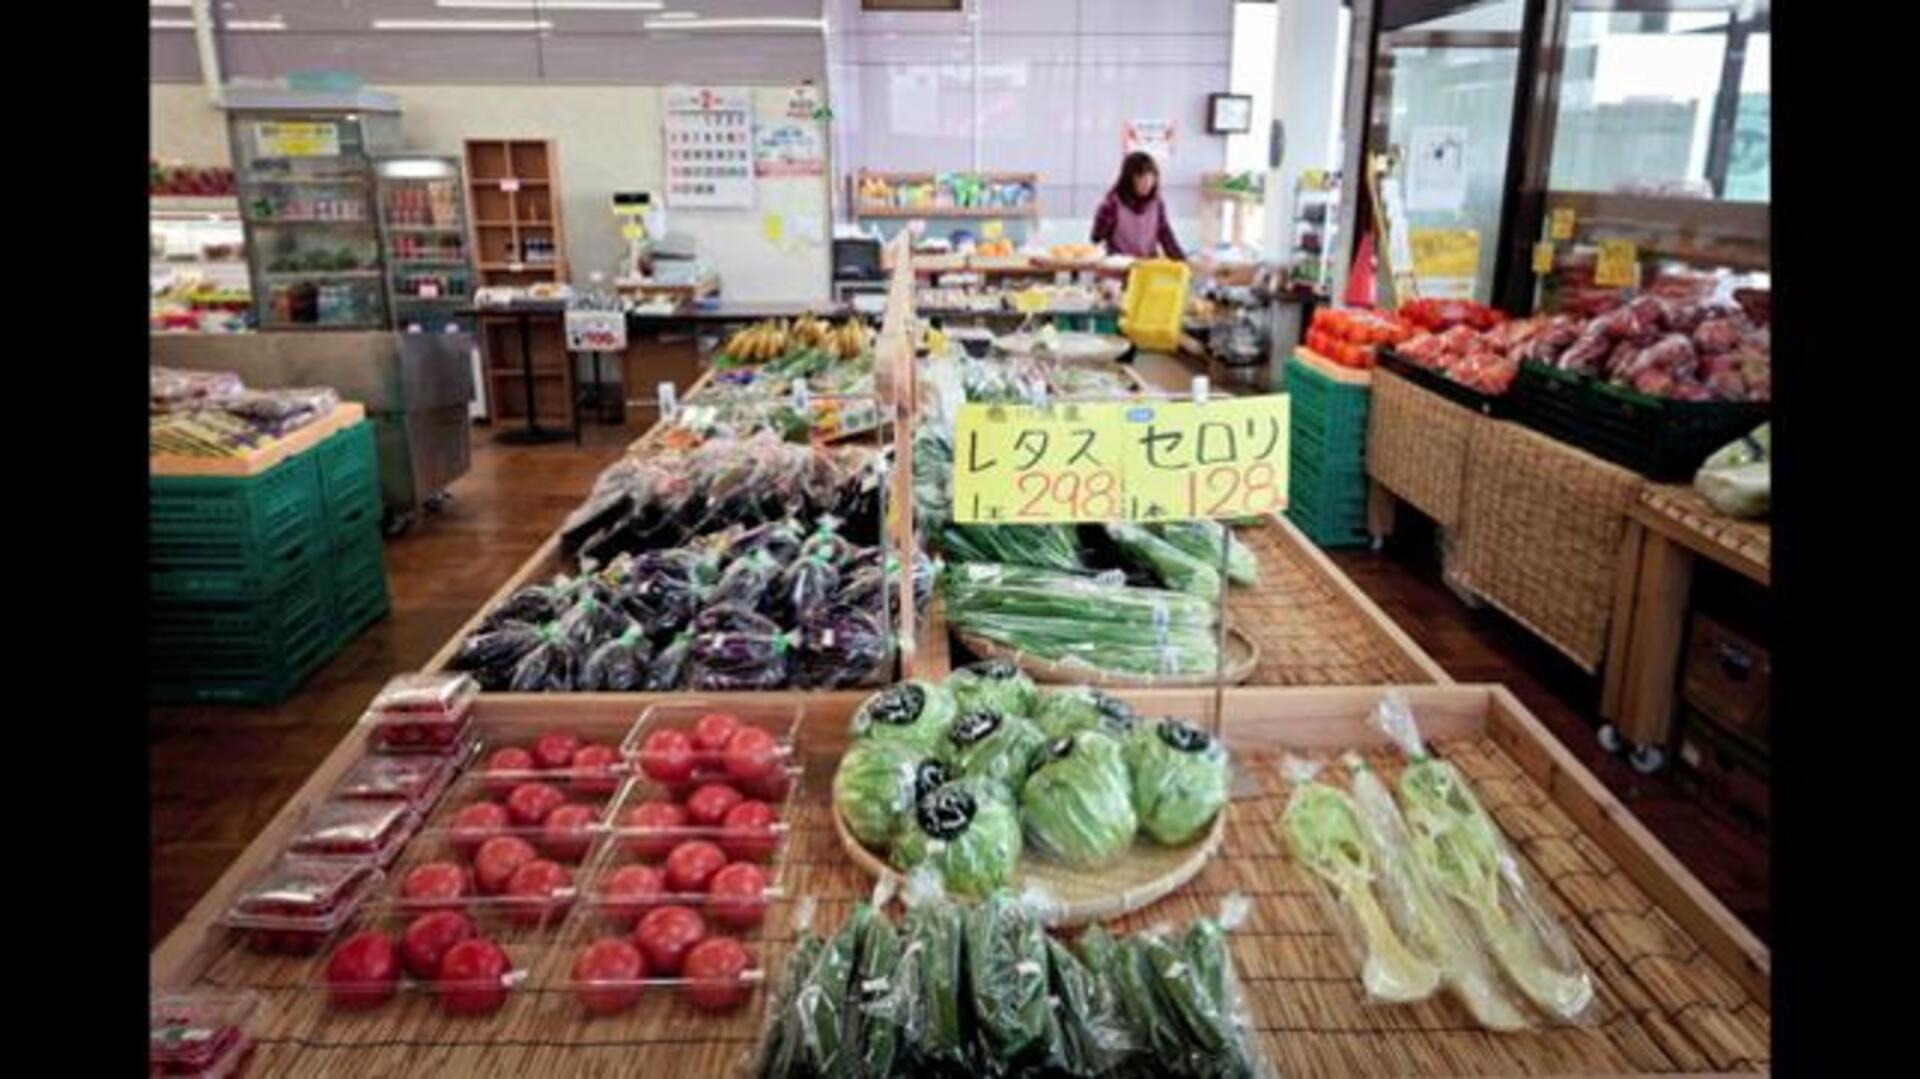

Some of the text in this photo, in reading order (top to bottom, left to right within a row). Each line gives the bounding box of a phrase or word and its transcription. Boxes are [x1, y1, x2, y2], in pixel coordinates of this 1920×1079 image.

[969, 429, 1101, 472] レタス
[1139, 417, 1280, 469] セロリ
[1016, 472, 1117, 519] 298
[1187, 465, 1279, 517] 128
